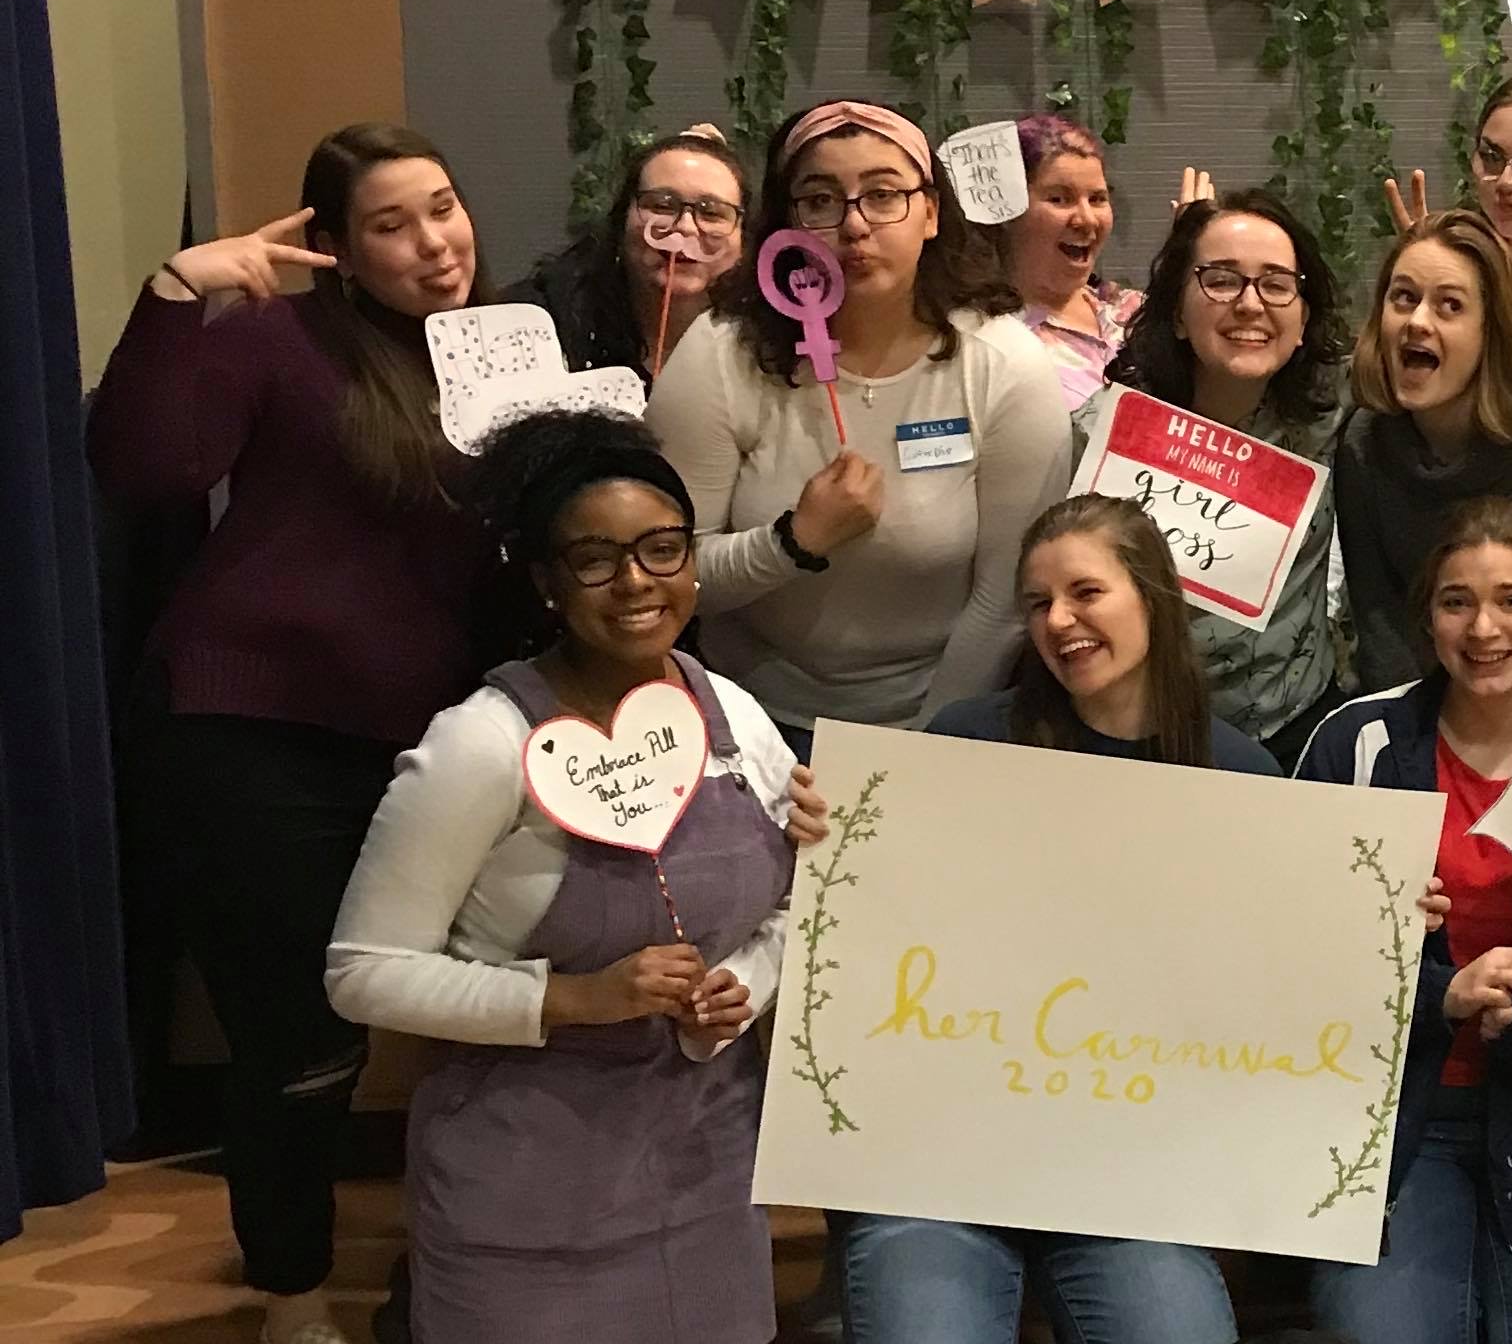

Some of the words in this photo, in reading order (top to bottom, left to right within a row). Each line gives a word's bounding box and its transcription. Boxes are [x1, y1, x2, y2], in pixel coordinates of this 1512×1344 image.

[964, 185, 1004, 205] Tea
[968, 164, 1000, 185] the
[911, 422, 955, 435] HELLO
[1167, 415, 1253, 462] HELLO
[1166, 445, 1187, 465] MY
[1187, 453, 1226, 481] NAME
[1227, 467, 1241, 488] IS
[1135, 470, 1251, 531] girl
[566, 754, 646, 787] Embrace
[644, 726, 679, 758] All
[588, 779, 627, 803] That
[632, 774, 655, 792] is
[864, 945, 1005, 1043] her
[1034, 976, 1365, 1084] Carnival
[1001, 1059, 1155, 1104] 2020
